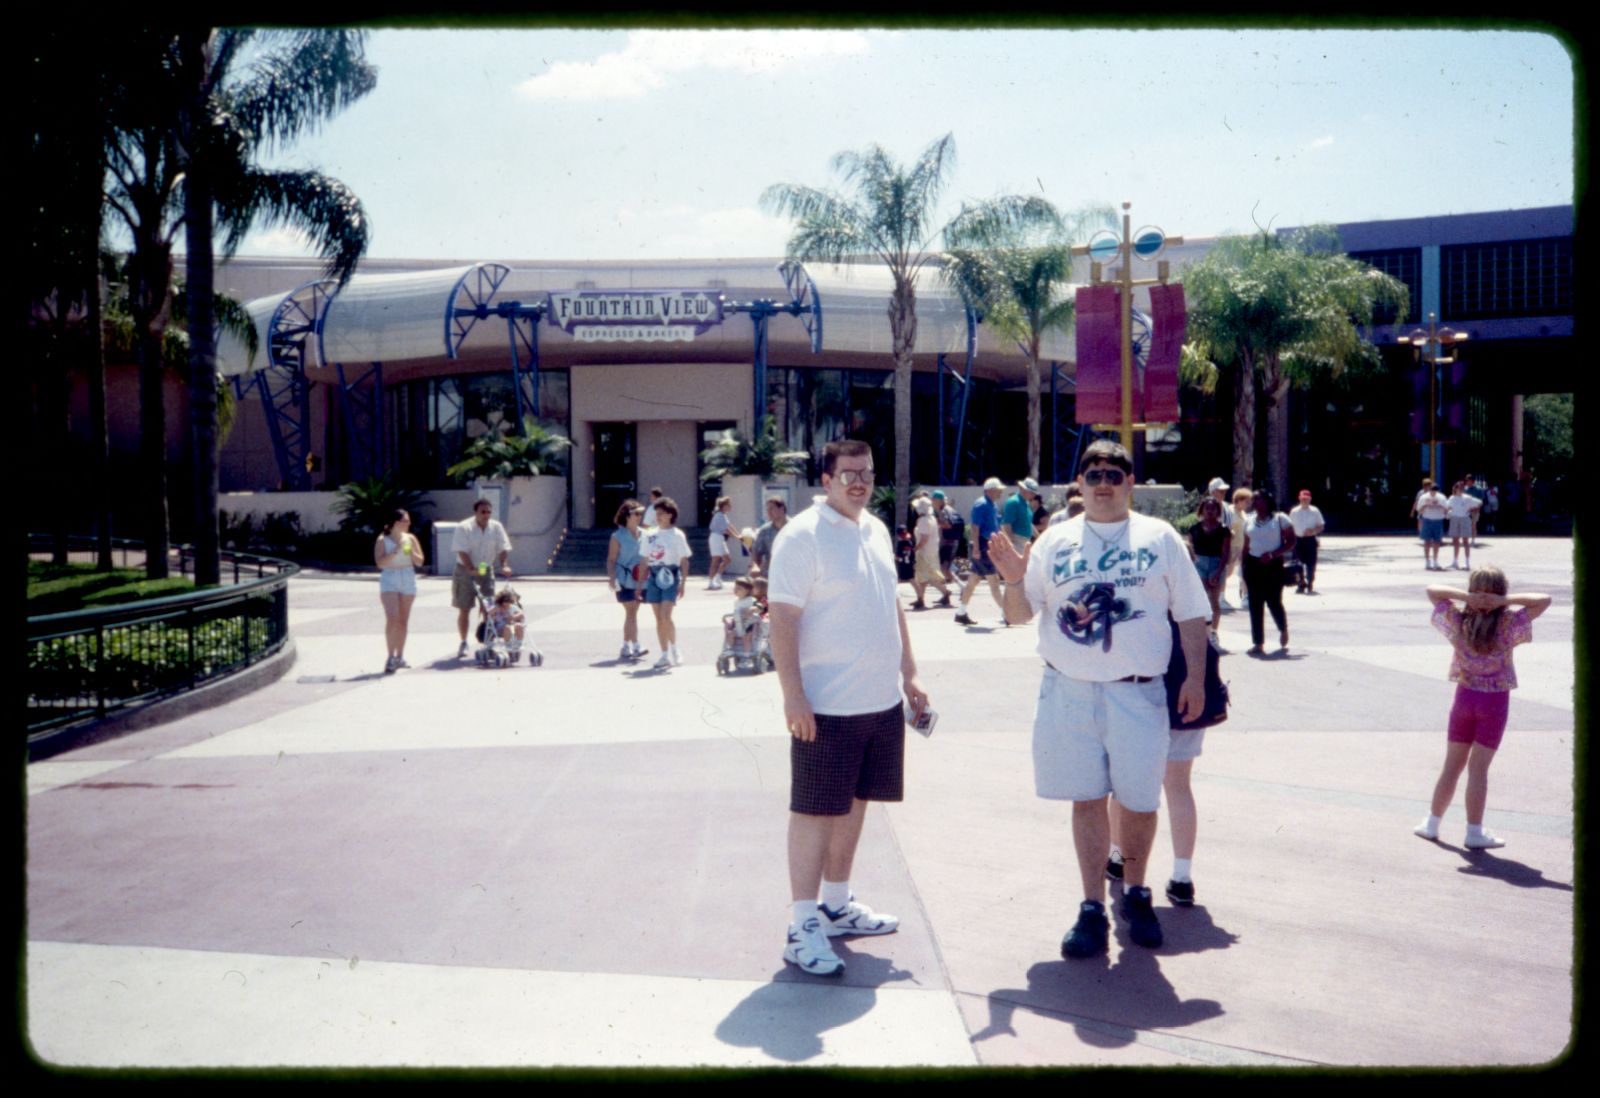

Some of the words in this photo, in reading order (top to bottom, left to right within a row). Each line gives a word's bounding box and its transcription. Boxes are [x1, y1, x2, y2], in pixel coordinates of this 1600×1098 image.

[560, 298, 654, 318] FOUNTAIN
[660, 297, 709, 317] VIEW
[581, 329, 634, 339] ESPRESSO
[647, 329, 687, 338] BAKERY
